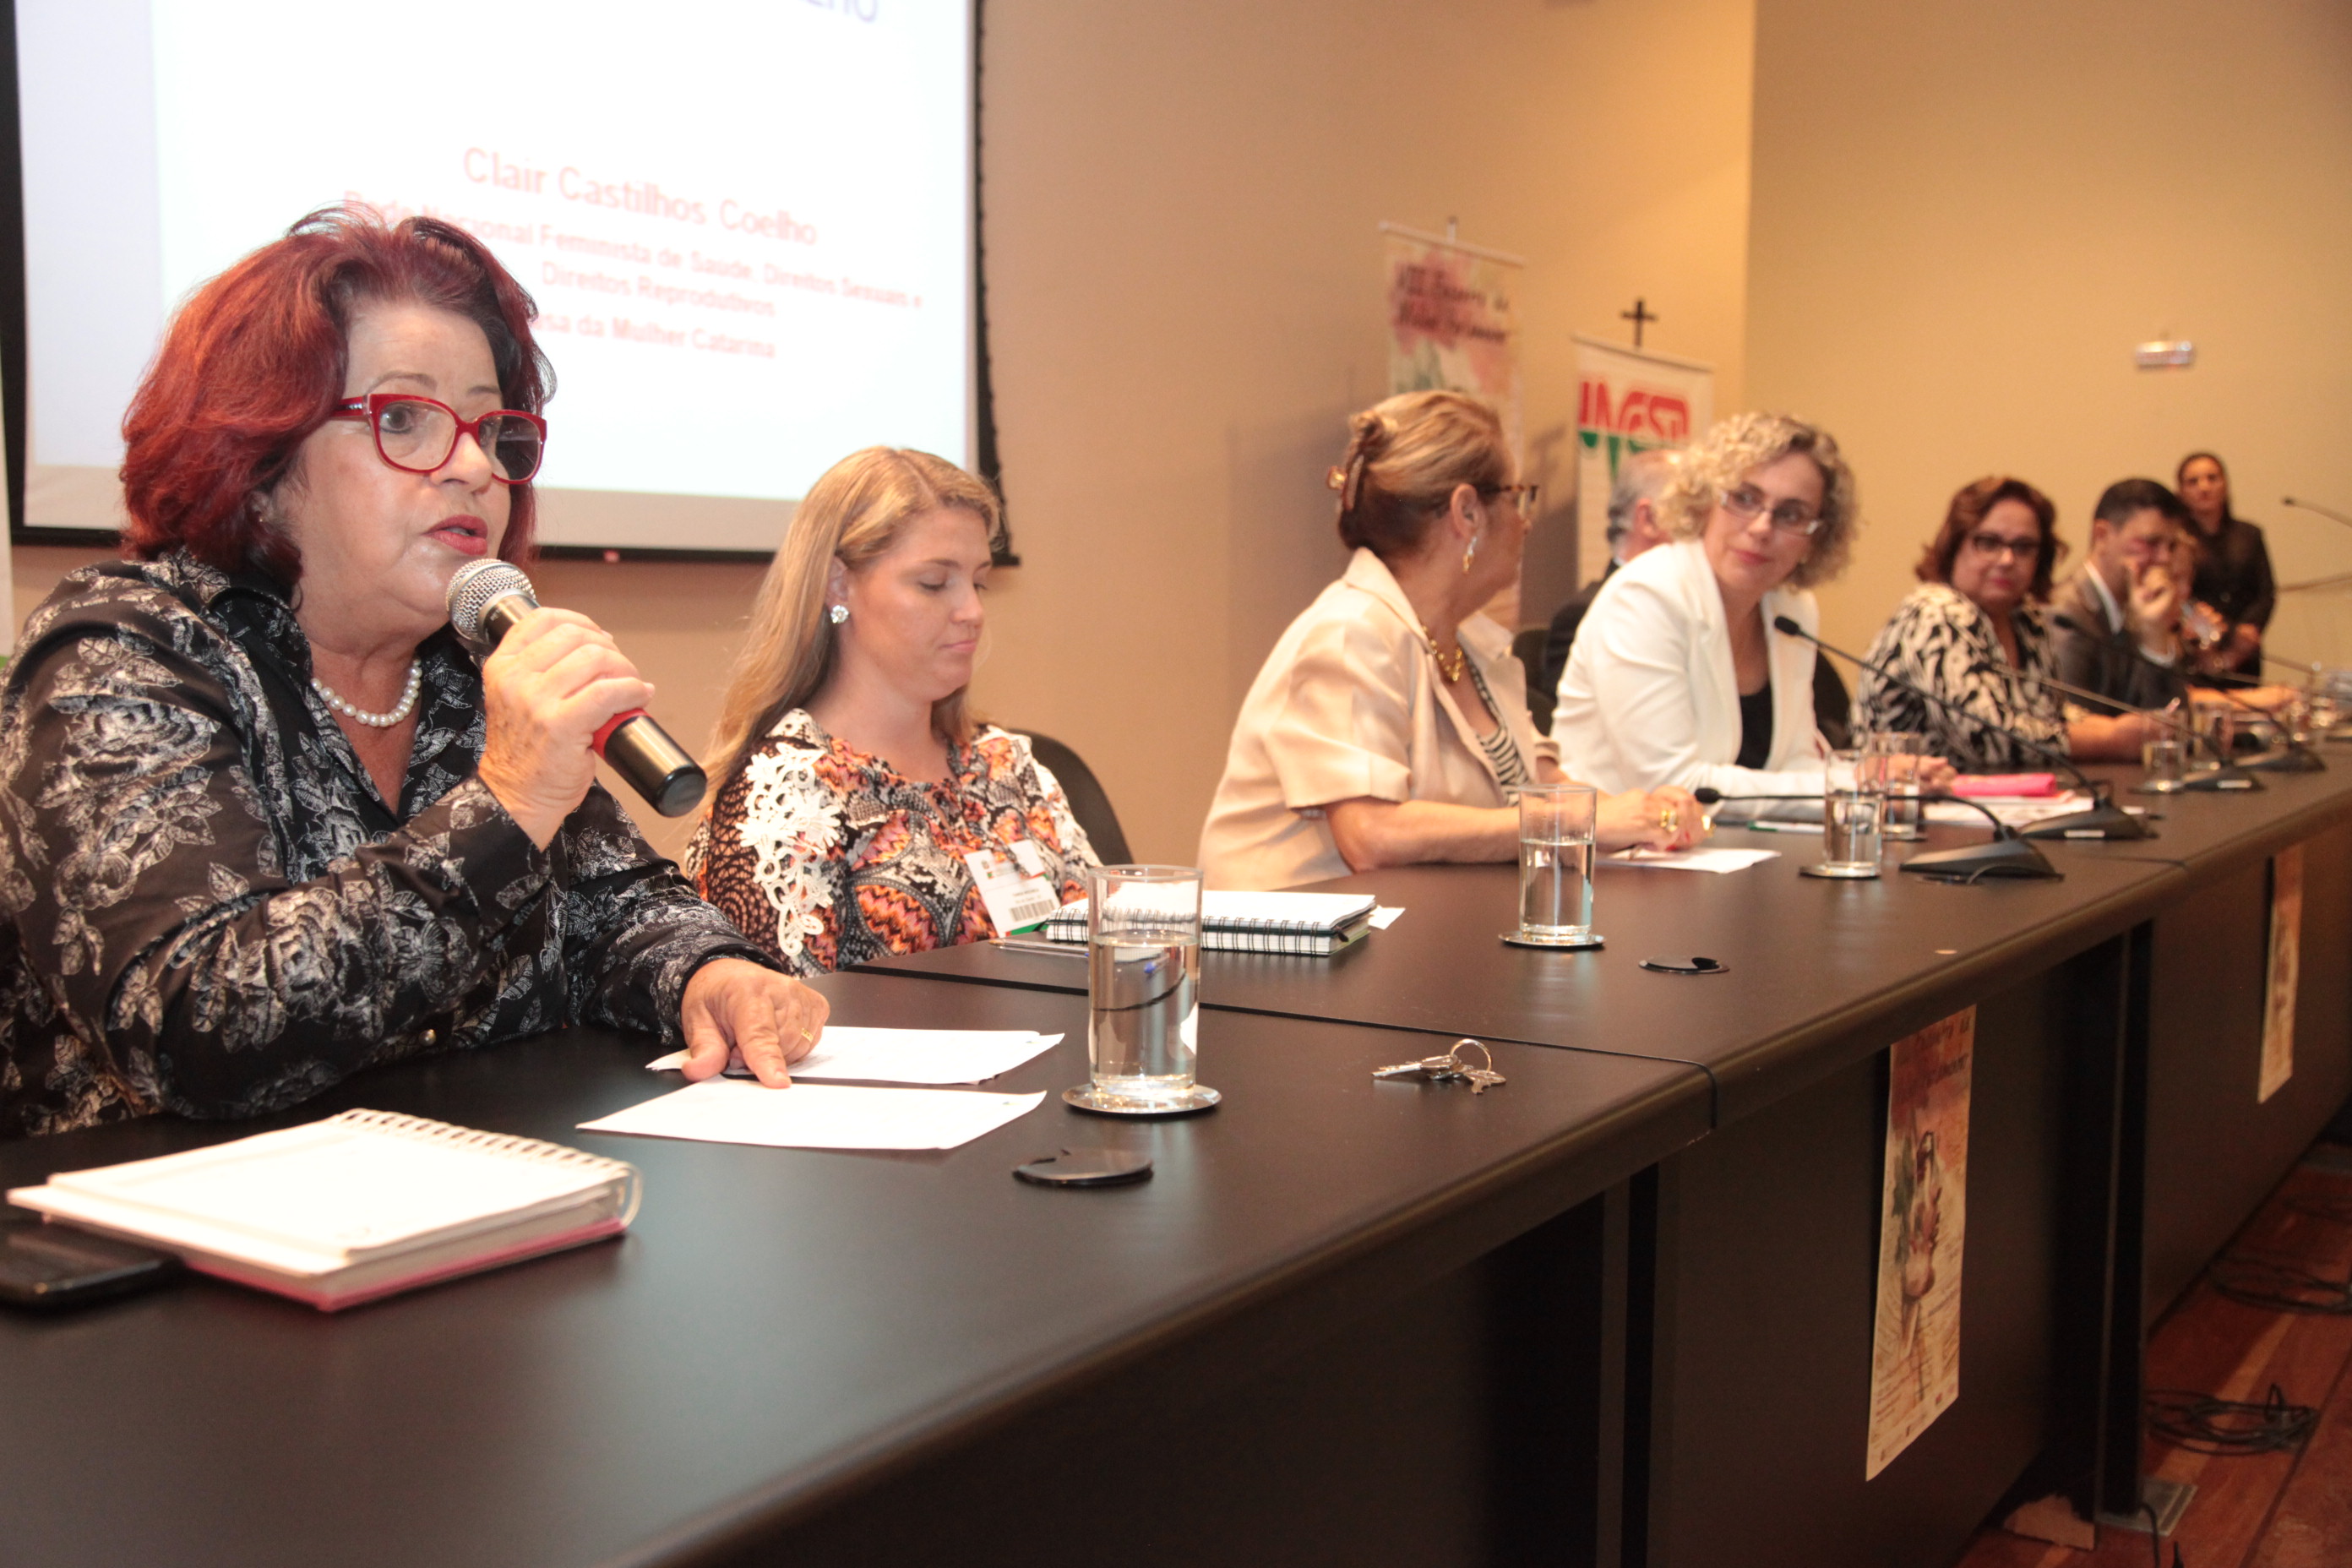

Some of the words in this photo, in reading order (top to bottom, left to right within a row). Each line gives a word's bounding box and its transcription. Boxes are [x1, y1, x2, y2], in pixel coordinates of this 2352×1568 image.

[463, 147, 547, 194] Clair
[558, 166, 706, 225] Castilhos
[719, 199, 816, 246] Coelho
[541, 224, 652, 265] Feminista
[658, 248, 682, 269] de
[764, 263, 836, 295] Direitos
[542, 260, 631, 297] Direitos
[637, 275, 776, 317] Reprodutivos
[532, 313, 571, 335] asa
[577, 314, 604, 338] da
[612, 316, 685, 346] Mulher
[691, 328, 776, 359] Catarina
